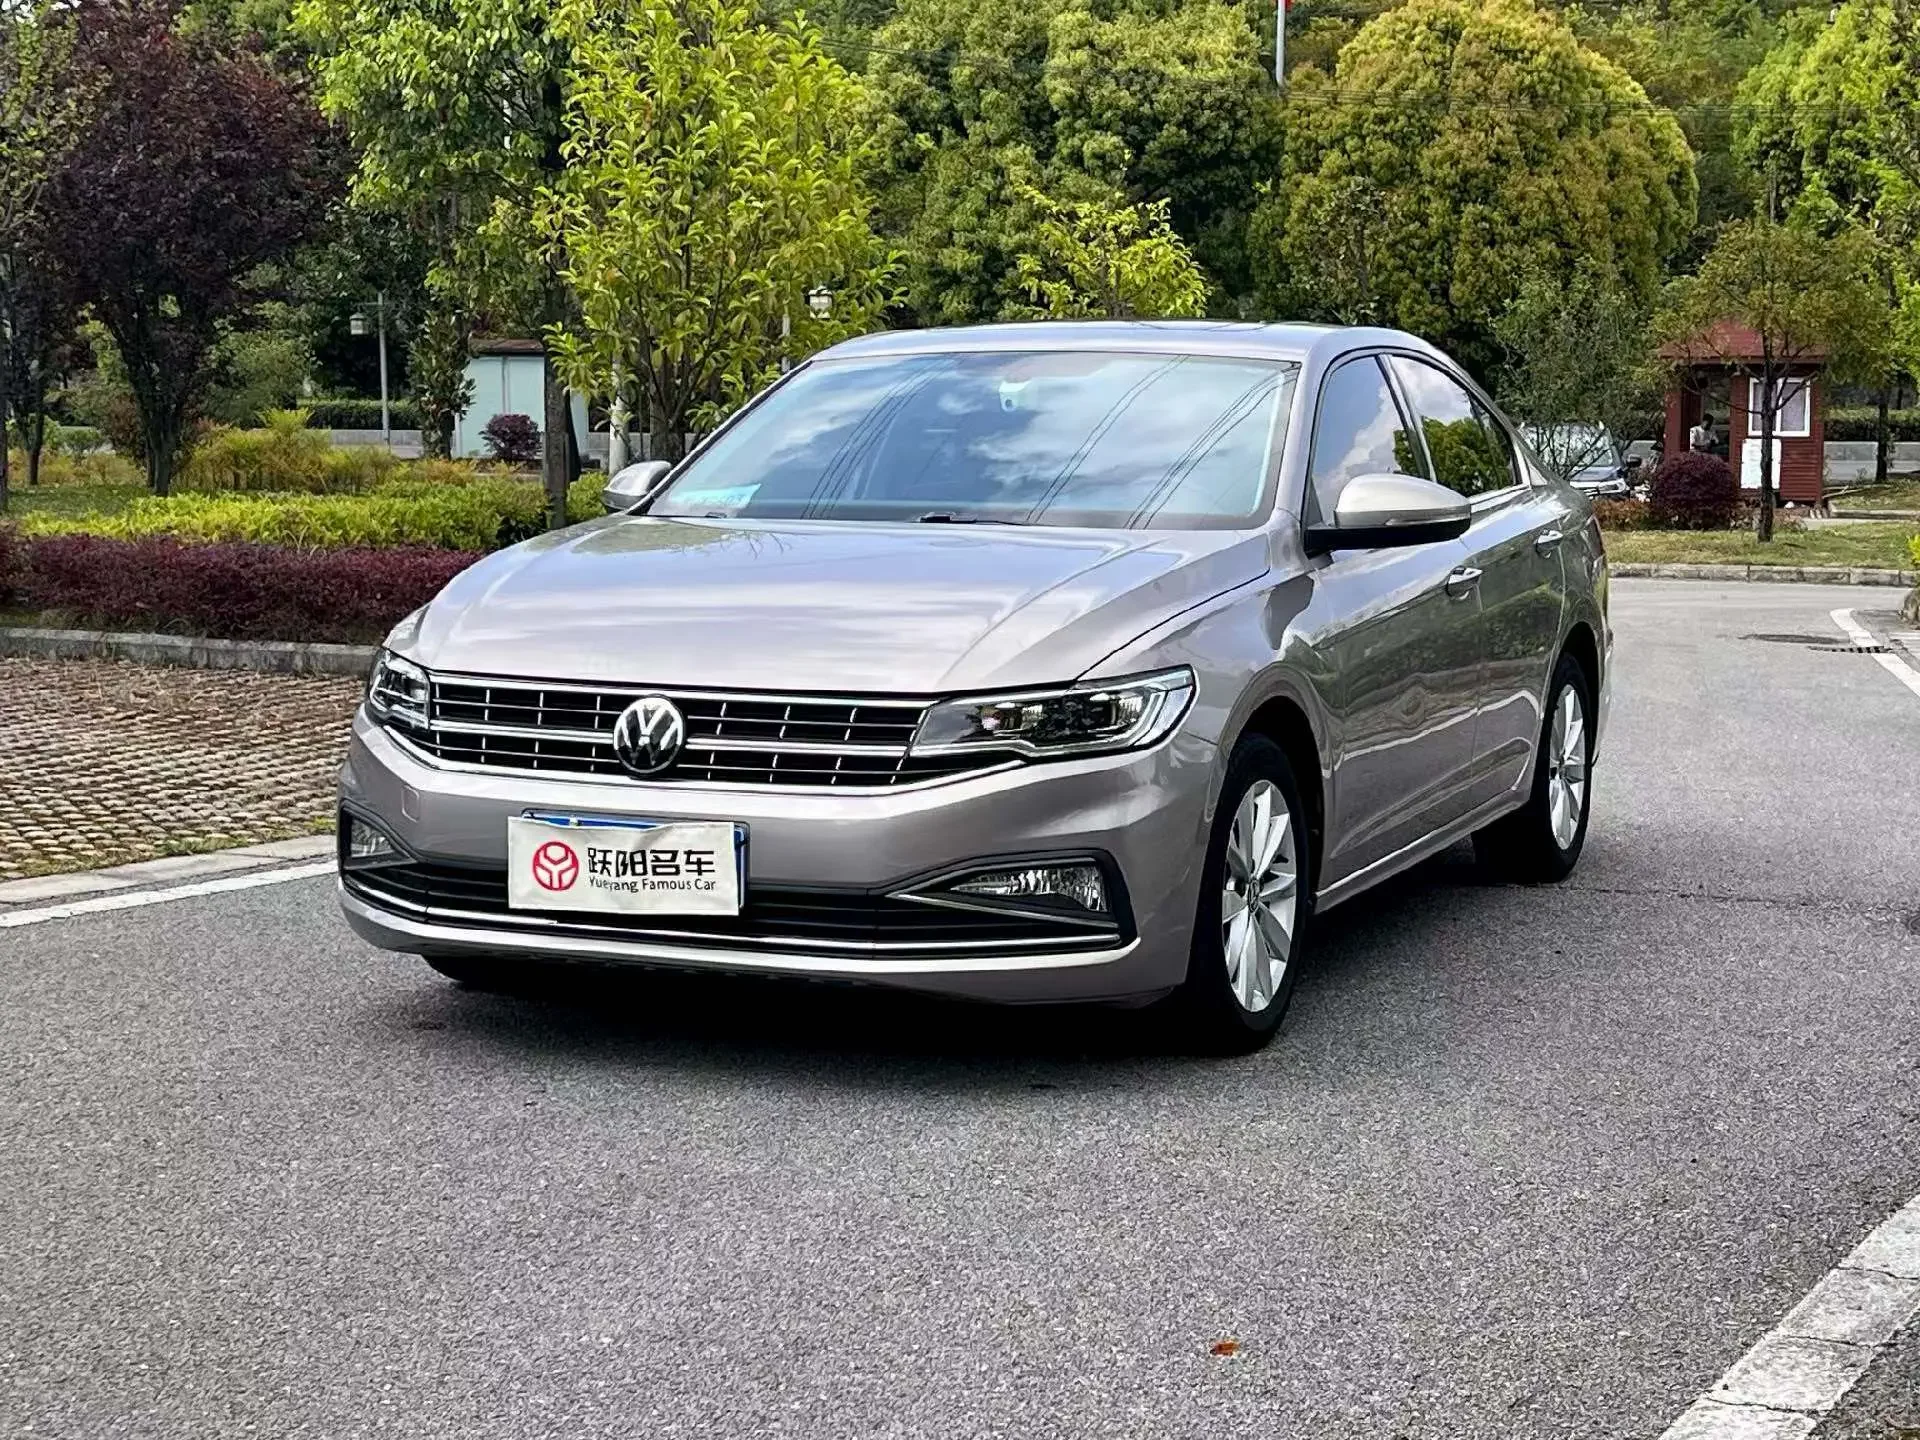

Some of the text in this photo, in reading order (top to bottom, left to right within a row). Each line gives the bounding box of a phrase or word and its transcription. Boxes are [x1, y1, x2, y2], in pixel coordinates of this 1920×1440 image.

[588, 848, 716, 878] 跃阳名车
[642, 878, 692, 890] Famous
[694, 878, 716, 890] Car
